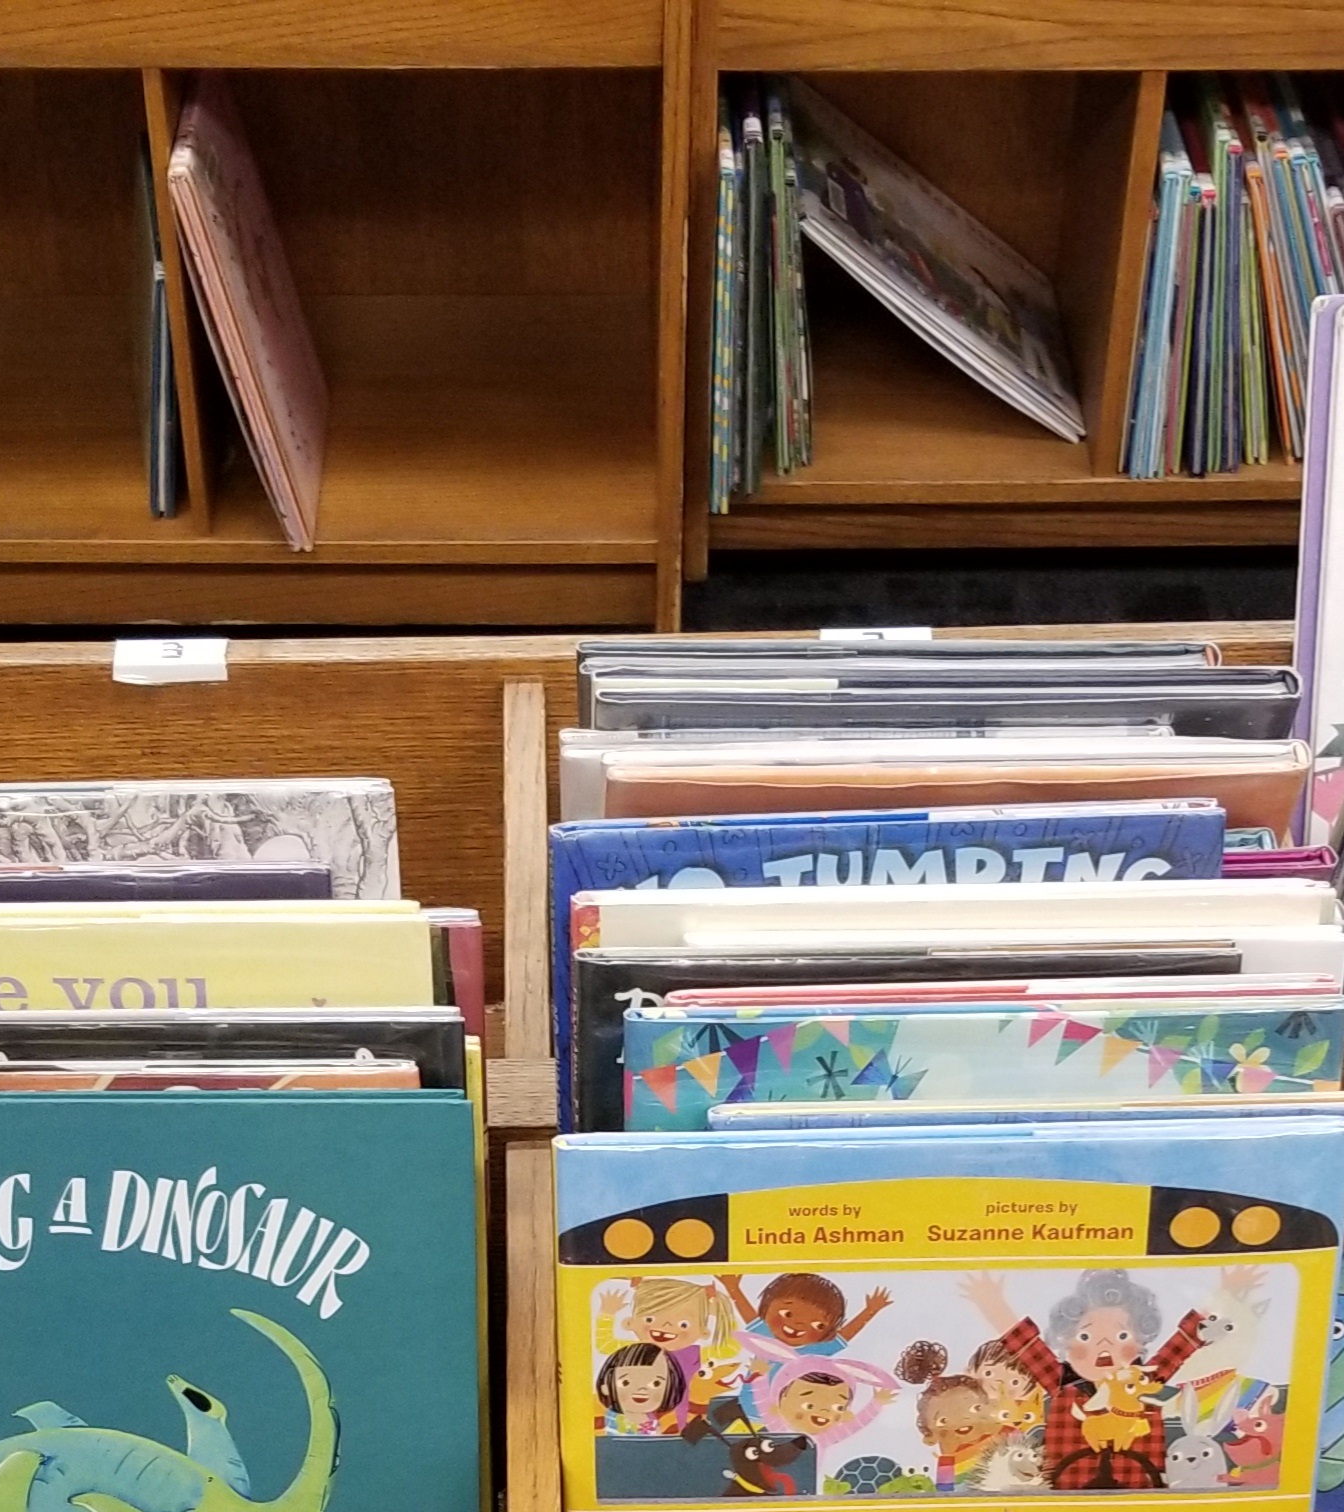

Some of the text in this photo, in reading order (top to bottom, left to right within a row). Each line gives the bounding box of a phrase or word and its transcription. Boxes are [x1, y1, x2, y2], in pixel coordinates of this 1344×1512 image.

[53, 976, 209, 1010] you
[788, 1200, 1079, 1222] words by pictures by
[49, 1176, 93, 1235] A
[101, 1165, 372, 1321] DINOSAUR
[745, 1220, 1134, 1247] Linda Ashman Suzanne Kaufman
